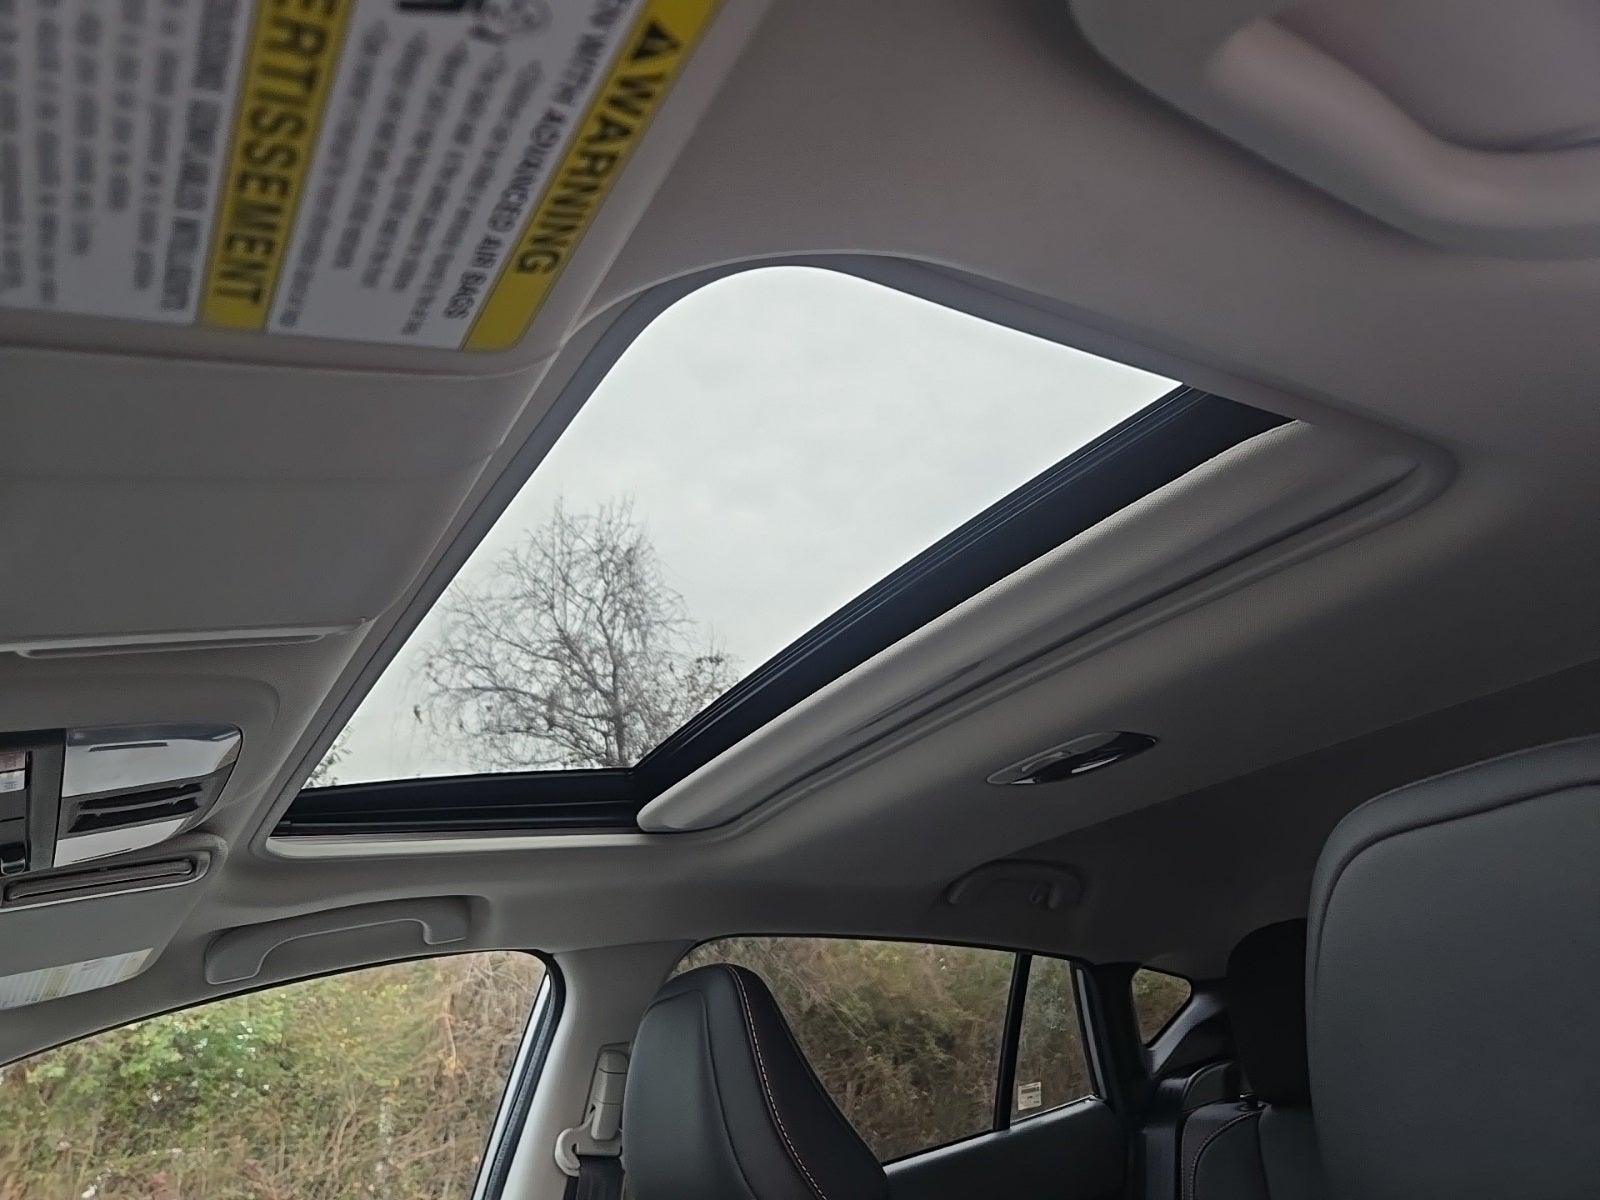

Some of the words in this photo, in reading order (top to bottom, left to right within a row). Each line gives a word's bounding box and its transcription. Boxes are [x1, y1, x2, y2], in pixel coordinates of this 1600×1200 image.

[551, 32, 606, 107] WITH
[486, 105, 567, 235] ADVANCED
[515, 71, 664, 275] WARNING
[470, 233, 503, 270] AIR
[443, 269, 488, 321] BAGS
